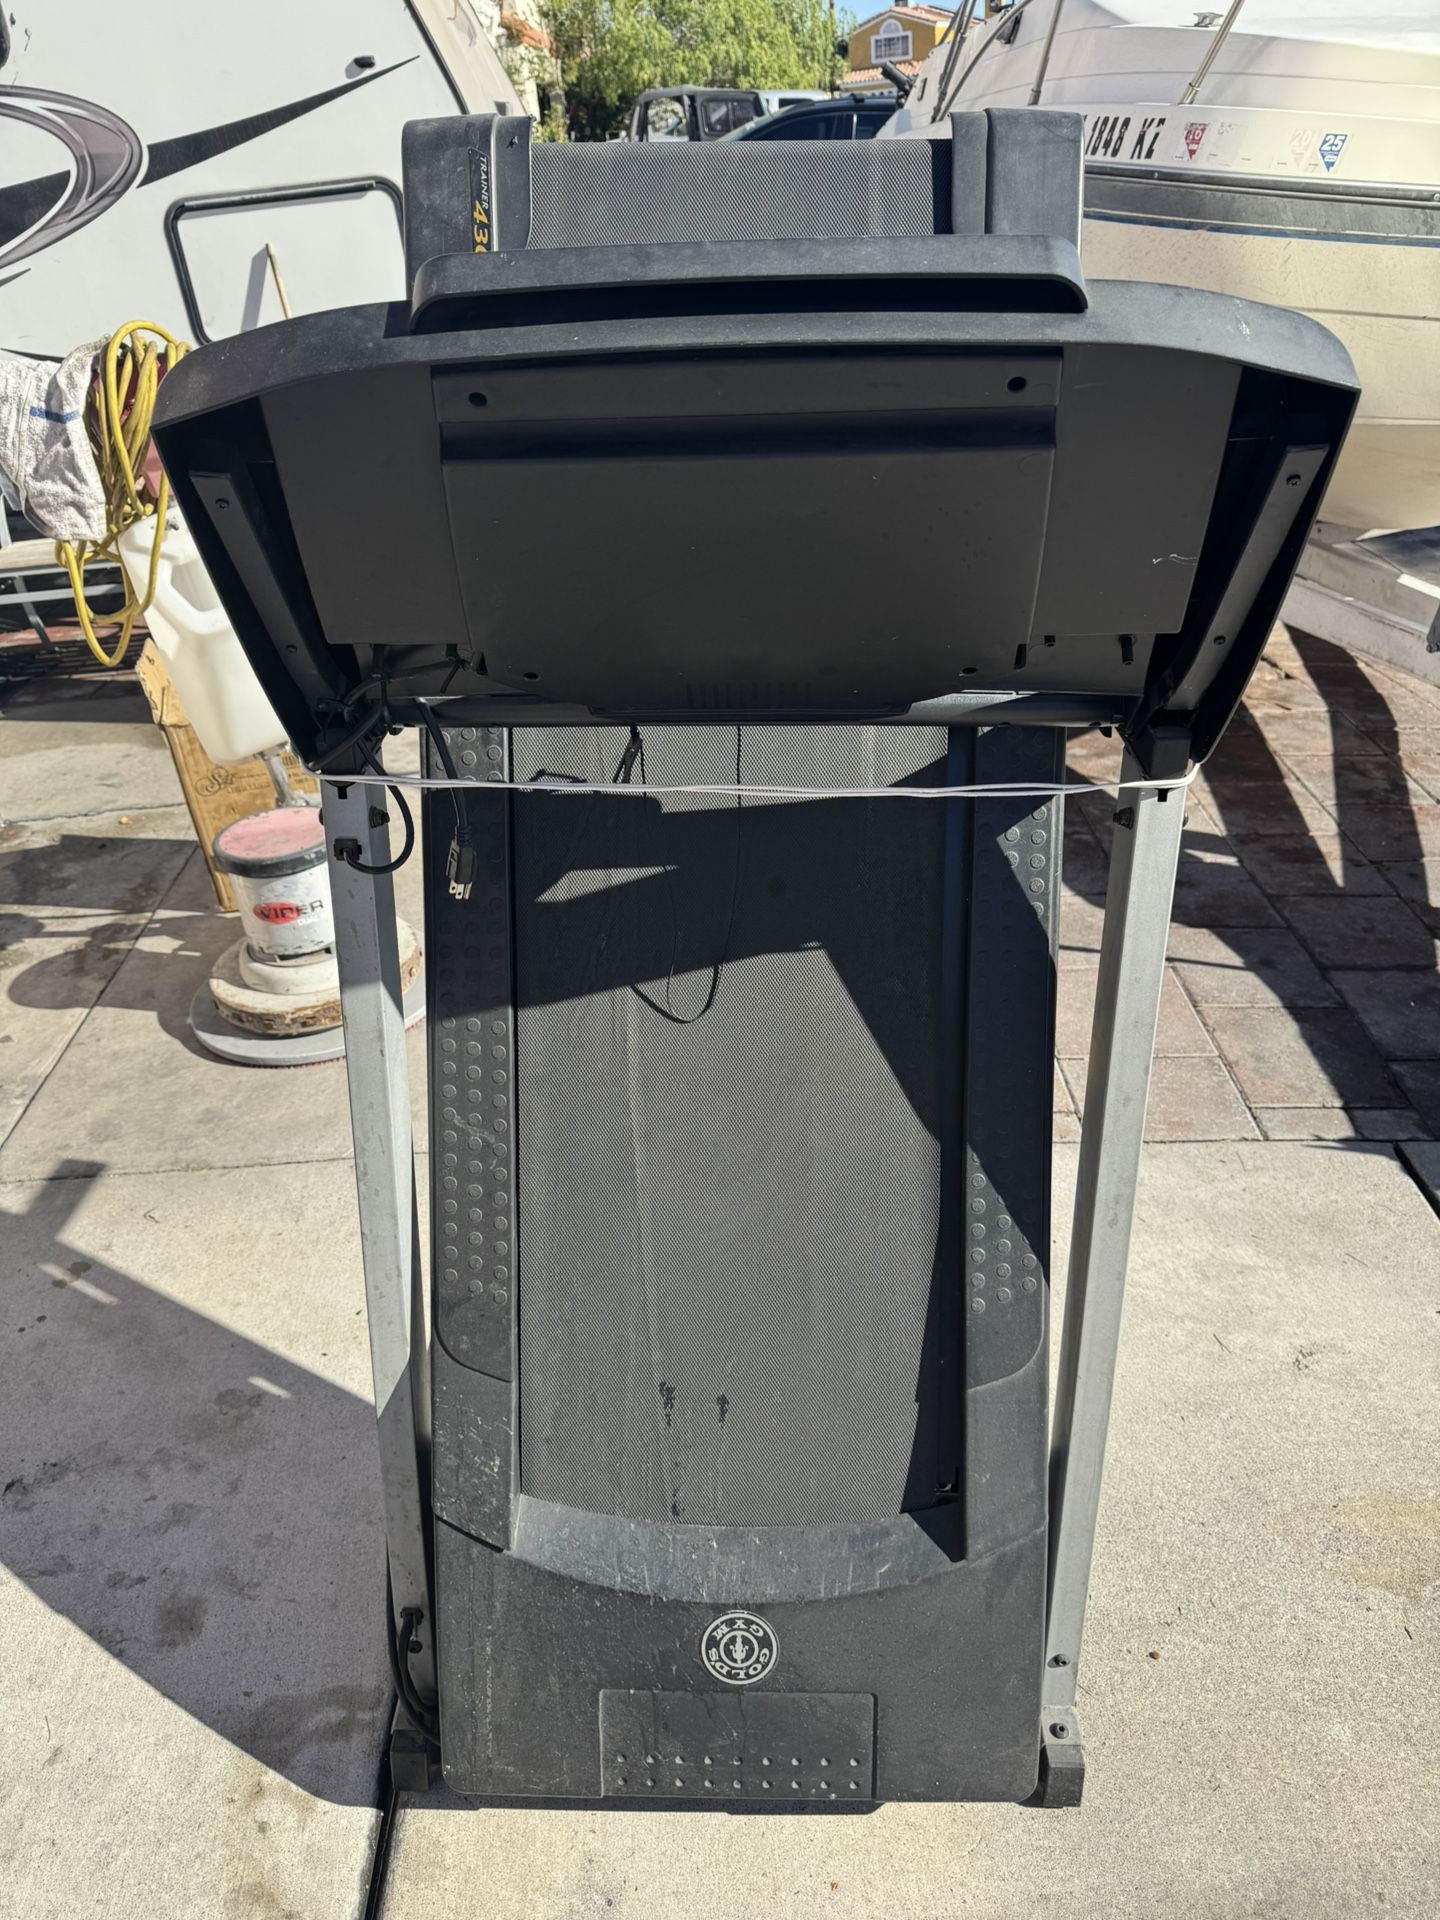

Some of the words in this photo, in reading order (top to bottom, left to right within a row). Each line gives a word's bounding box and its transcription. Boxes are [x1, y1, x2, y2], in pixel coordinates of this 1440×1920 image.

[1085, 115, 1131, 158] 1848
[1320, 134, 1346, 151] 25
[479, 155, 490, 210] TRAINER
[260, 899, 325, 920] VIPER
[711, 1619, 765, 1641] GYM
[707, 1647, 770, 1680] GOLD'S
